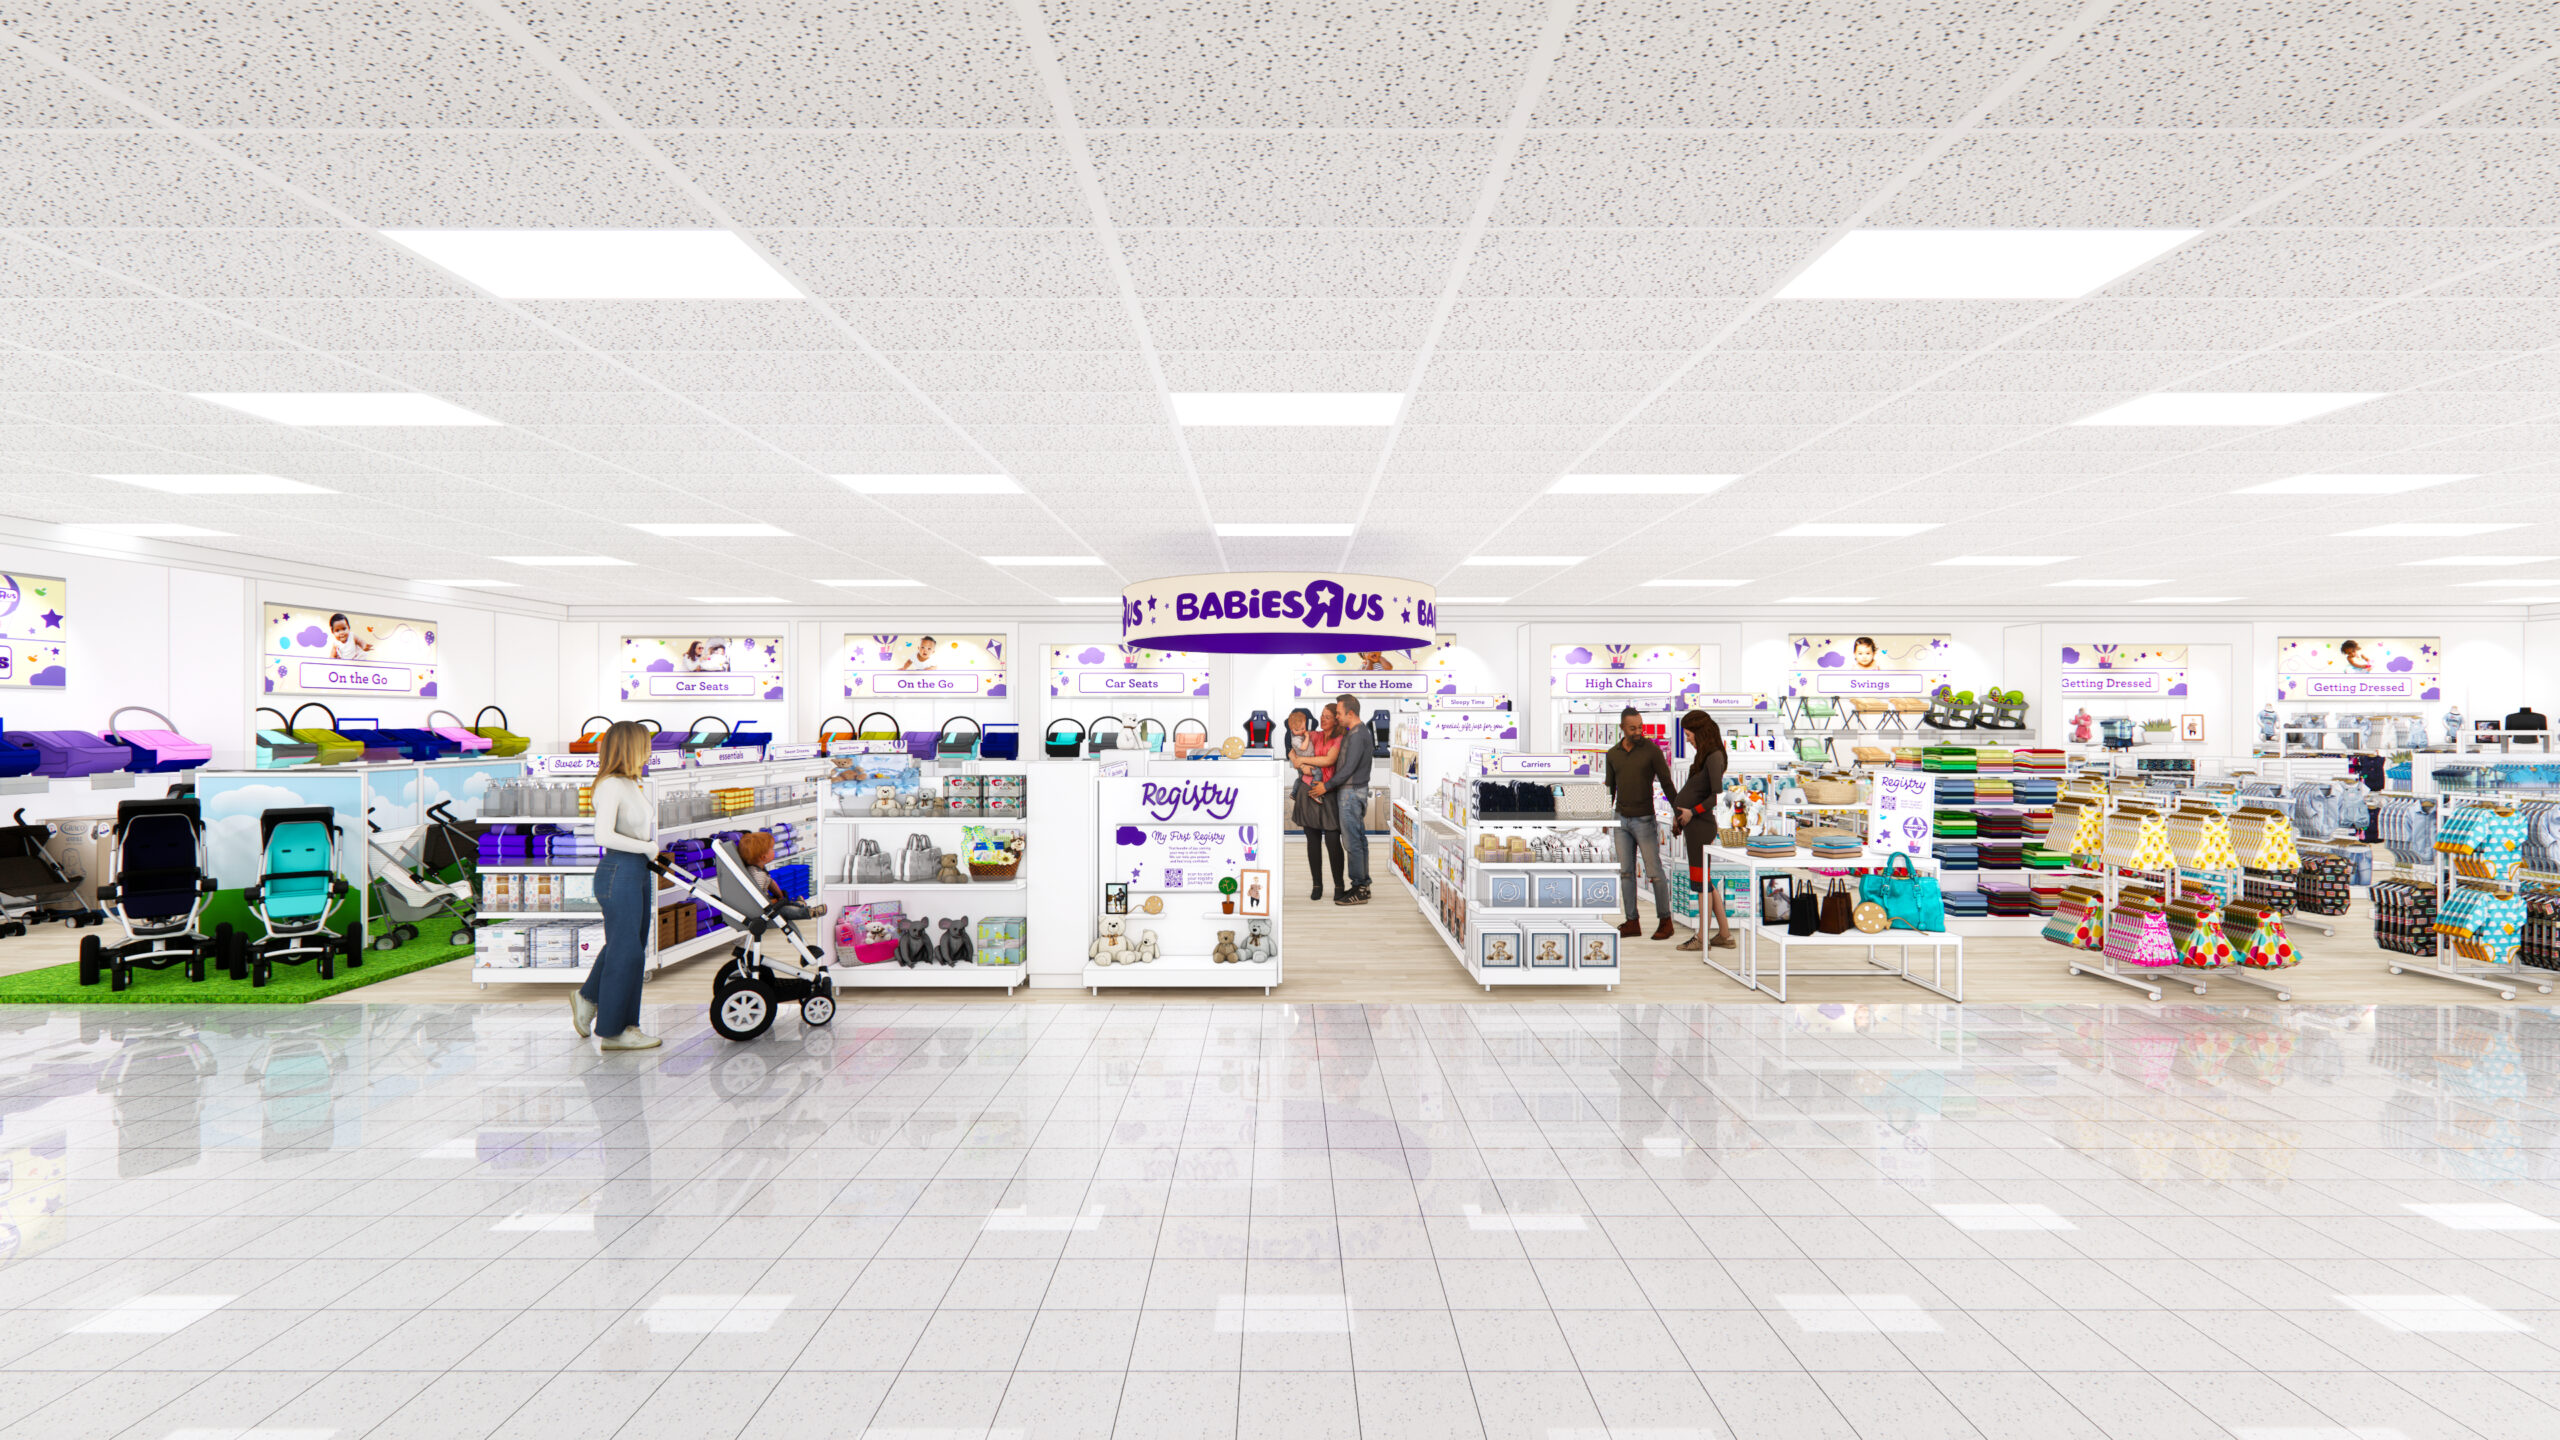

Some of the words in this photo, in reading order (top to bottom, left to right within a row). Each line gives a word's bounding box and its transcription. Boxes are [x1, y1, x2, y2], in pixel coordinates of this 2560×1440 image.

[328, 671, 347, 684] On
[350, 671, 369, 685] the
[371, 673, 388, 685] Go
[897, 679, 915, 690] On
[917, 678, 936, 690] the
[937, 679, 955, 690] Go
[1105, 678, 1126, 689] Car
[1128, 678, 1160, 689] Seats
[1337, 679, 1357, 689] For
[1359, 678, 1378, 689] the
[1379, 679, 1413, 689] Home
[1585, 677, 1613, 691] High
[1615, 677, 1654, 689] Chairs
[2061, 678, 2104, 691] Getting
[2106, 677, 2153, 688] Dressed
[675, 681, 697, 692] Car
[699, 681, 730, 692] Seats
[1850, 679, 1890, 691] Swings
[2313, 682, 2357, 694] Getting
[2359, 682, 2405, 692] Dressed
[718, 750, 745, 761] essentials
[554, 759, 583, 769] Sweet
[1521, 760, 1552, 768] Carriers
[1881, 776, 1927, 795] Registry
[1141, 779, 1239, 821] Registry
[1151, 830, 1168, 845] My
[1169, 830, 1192, 842] First
[1193, 830, 1226, 845] Registry
